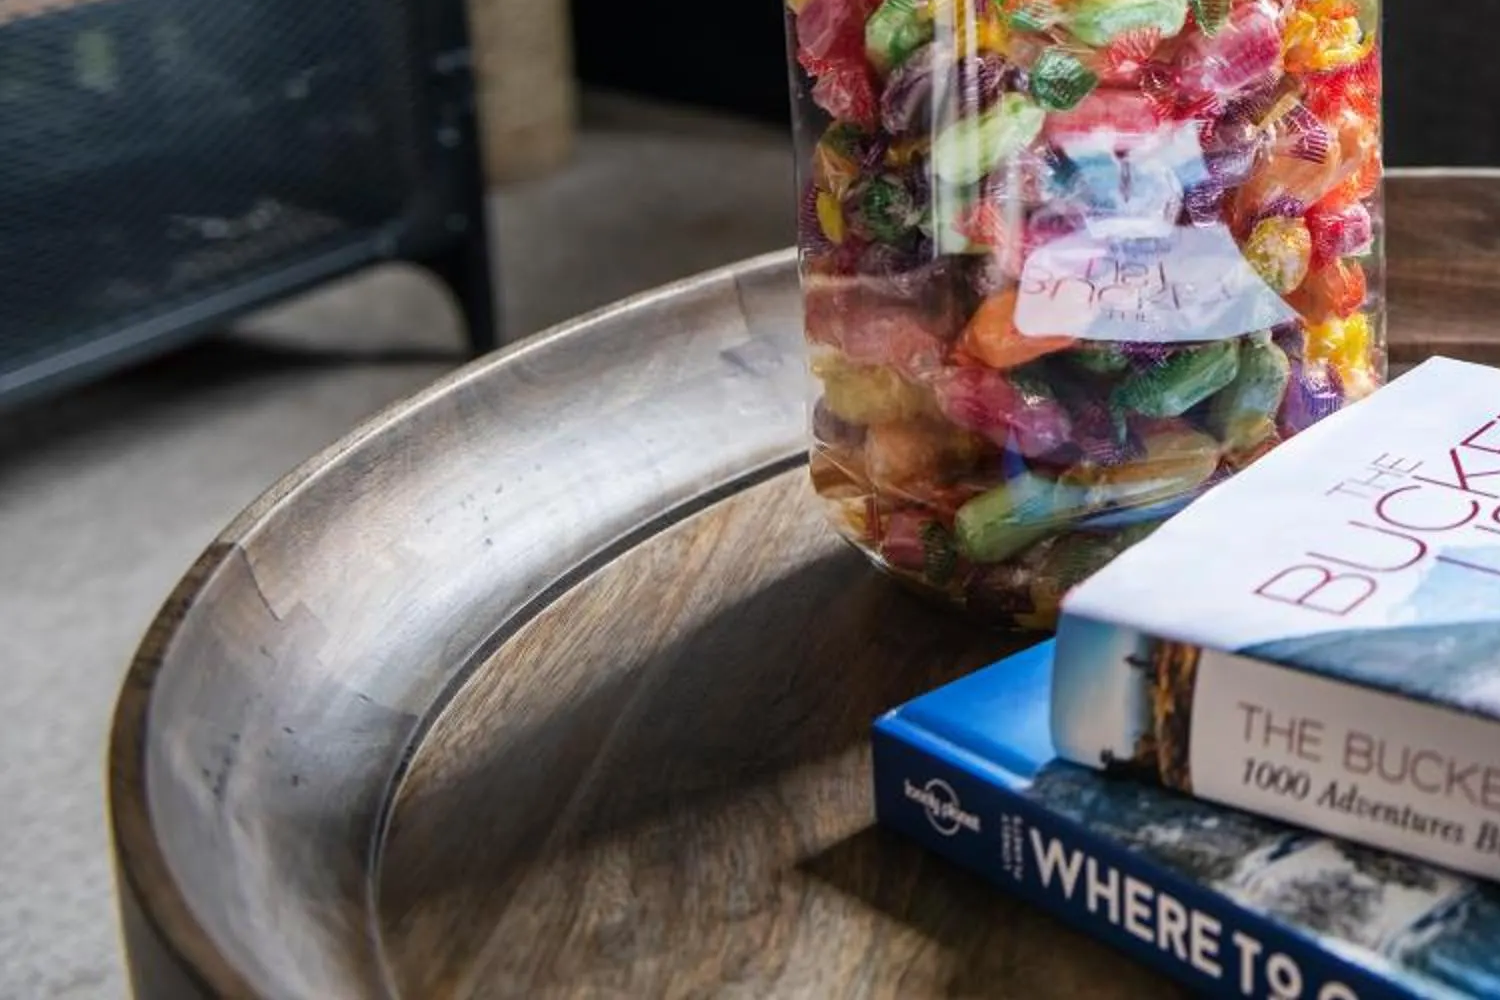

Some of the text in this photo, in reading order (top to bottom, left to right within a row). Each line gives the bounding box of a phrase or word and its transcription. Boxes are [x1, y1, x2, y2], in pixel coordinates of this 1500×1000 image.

[1324, 451, 1426, 498] THE
[1236, 701, 1325, 764] THE
[1241, 757, 1312, 801] 1000
[1317, 781, 1466, 846] Adventures
[1030, 827, 1224, 980] WHERE
[1232, 930, 1303, 1000] TO
